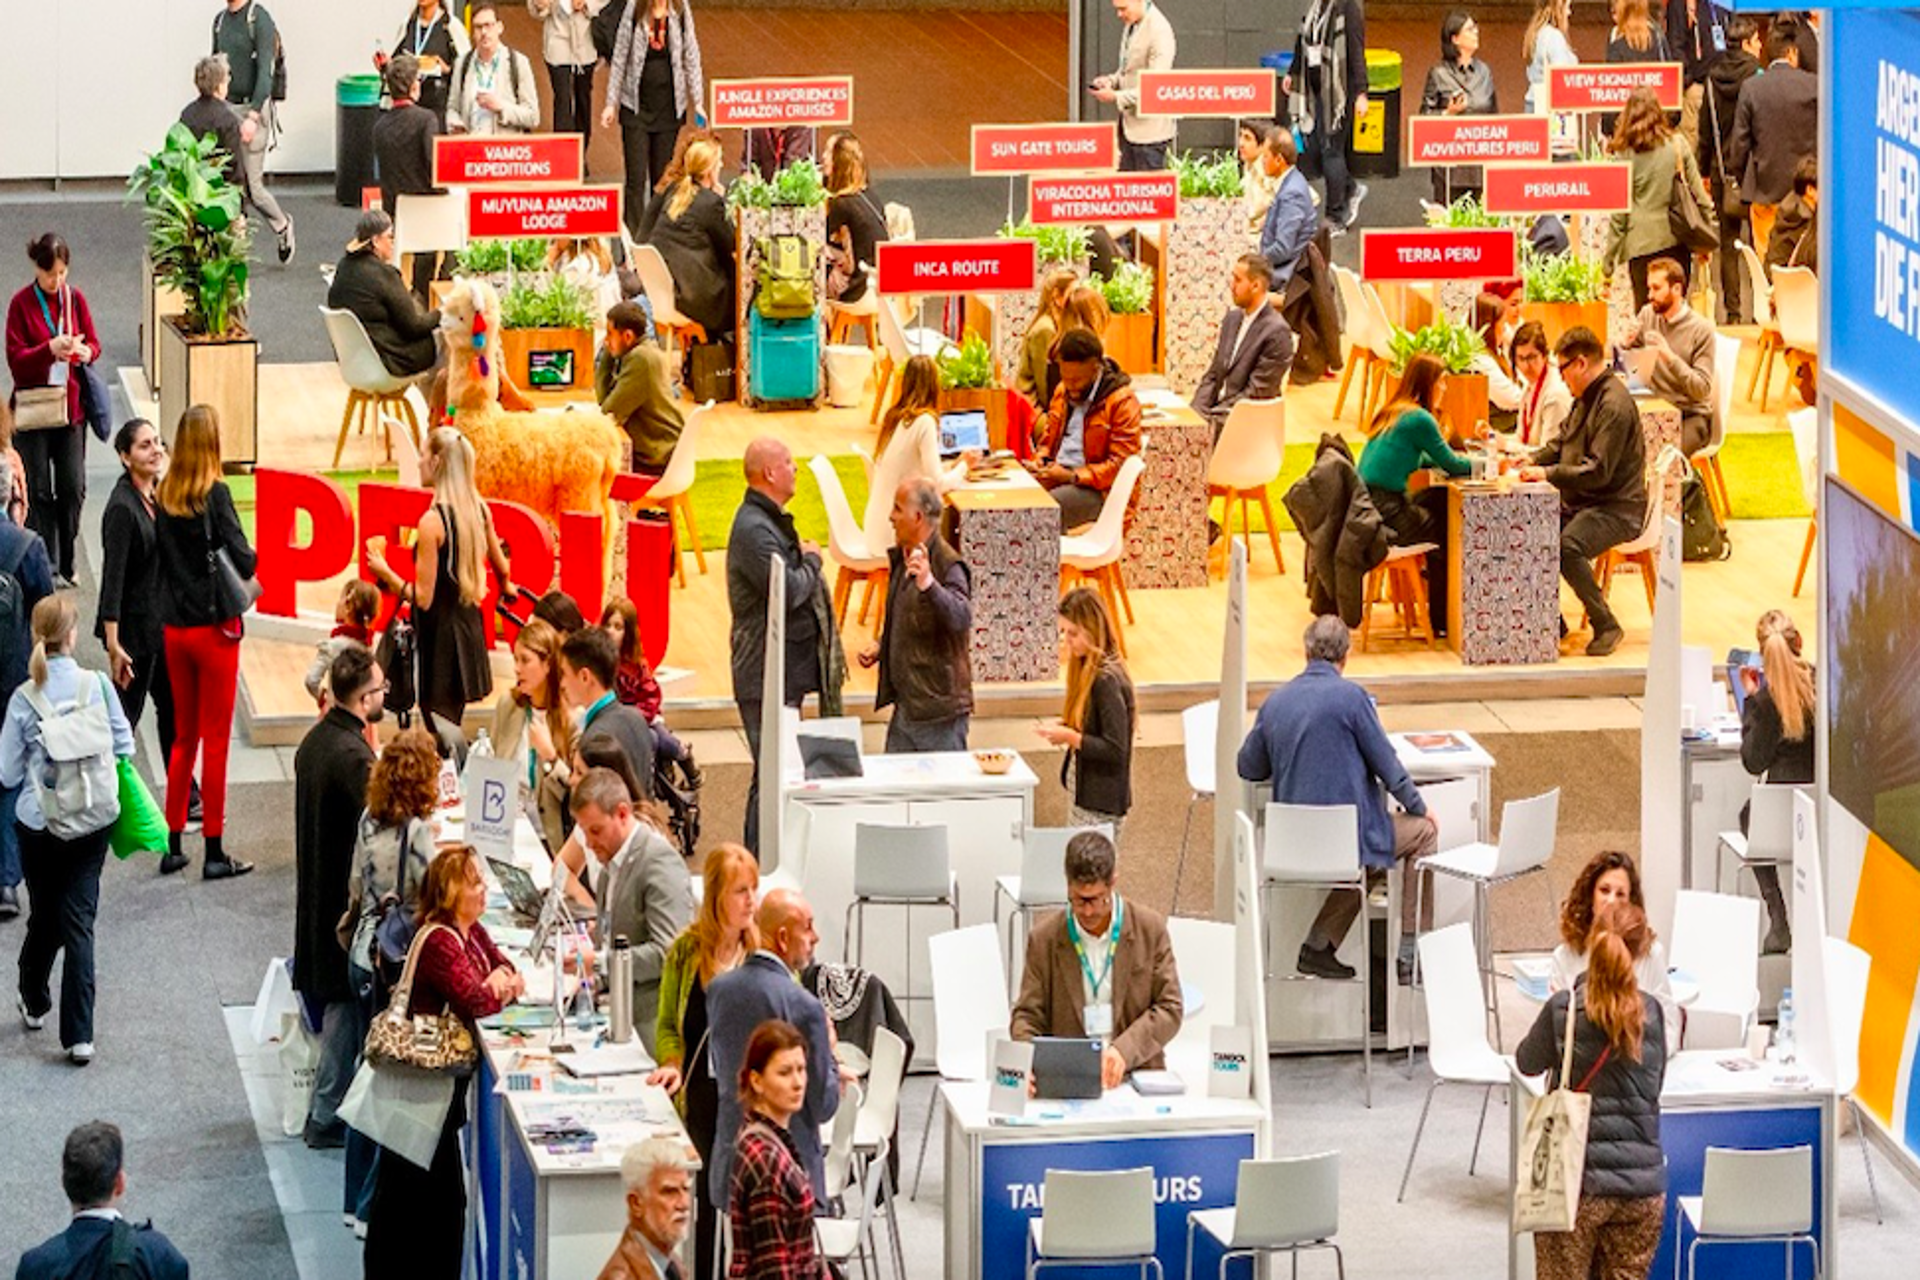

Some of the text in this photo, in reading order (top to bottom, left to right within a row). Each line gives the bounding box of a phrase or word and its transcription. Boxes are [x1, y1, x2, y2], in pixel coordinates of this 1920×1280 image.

[1563, 72, 1663, 88] VIEW SIGNATURE
[717, 86, 848, 104] JUNGLE EXPERIENCES
[1157, 85, 1195, 101] CASAS
[1197, 85, 1221, 101] DEL
[727, 102, 836, 119] AMAZON CRUISES
[1454, 125, 1509, 140] ANDEAN
[484, 145, 532, 161] VAMOS
[991, 139, 1098, 158] SUN GATE TOURS
[1421, 140, 1540, 157] ADVENTURES PERU
[464, 161, 551, 178] EXPEDITIONS
[1034, 182, 1174, 201] VIRACOCHA TURISMO
[1524, 181, 1591, 198] PERURAIL
[1875, 135, 1919, 244] HIER
[481, 195, 608, 214] MUYUNA AMAZON
[1051, 200, 1158, 218] INTERNACIONAL
[521, 213, 568, 230] LODGE
[1396, 245, 1482, 263] TERRA PERU
[913, 258, 1001, 278] INCA ROUTE
[1874, 229, 1906, 333] DIE
[1213, 1060, 1241, 1072] TOURS
[1152, 1175, 1204, 1203] URS
